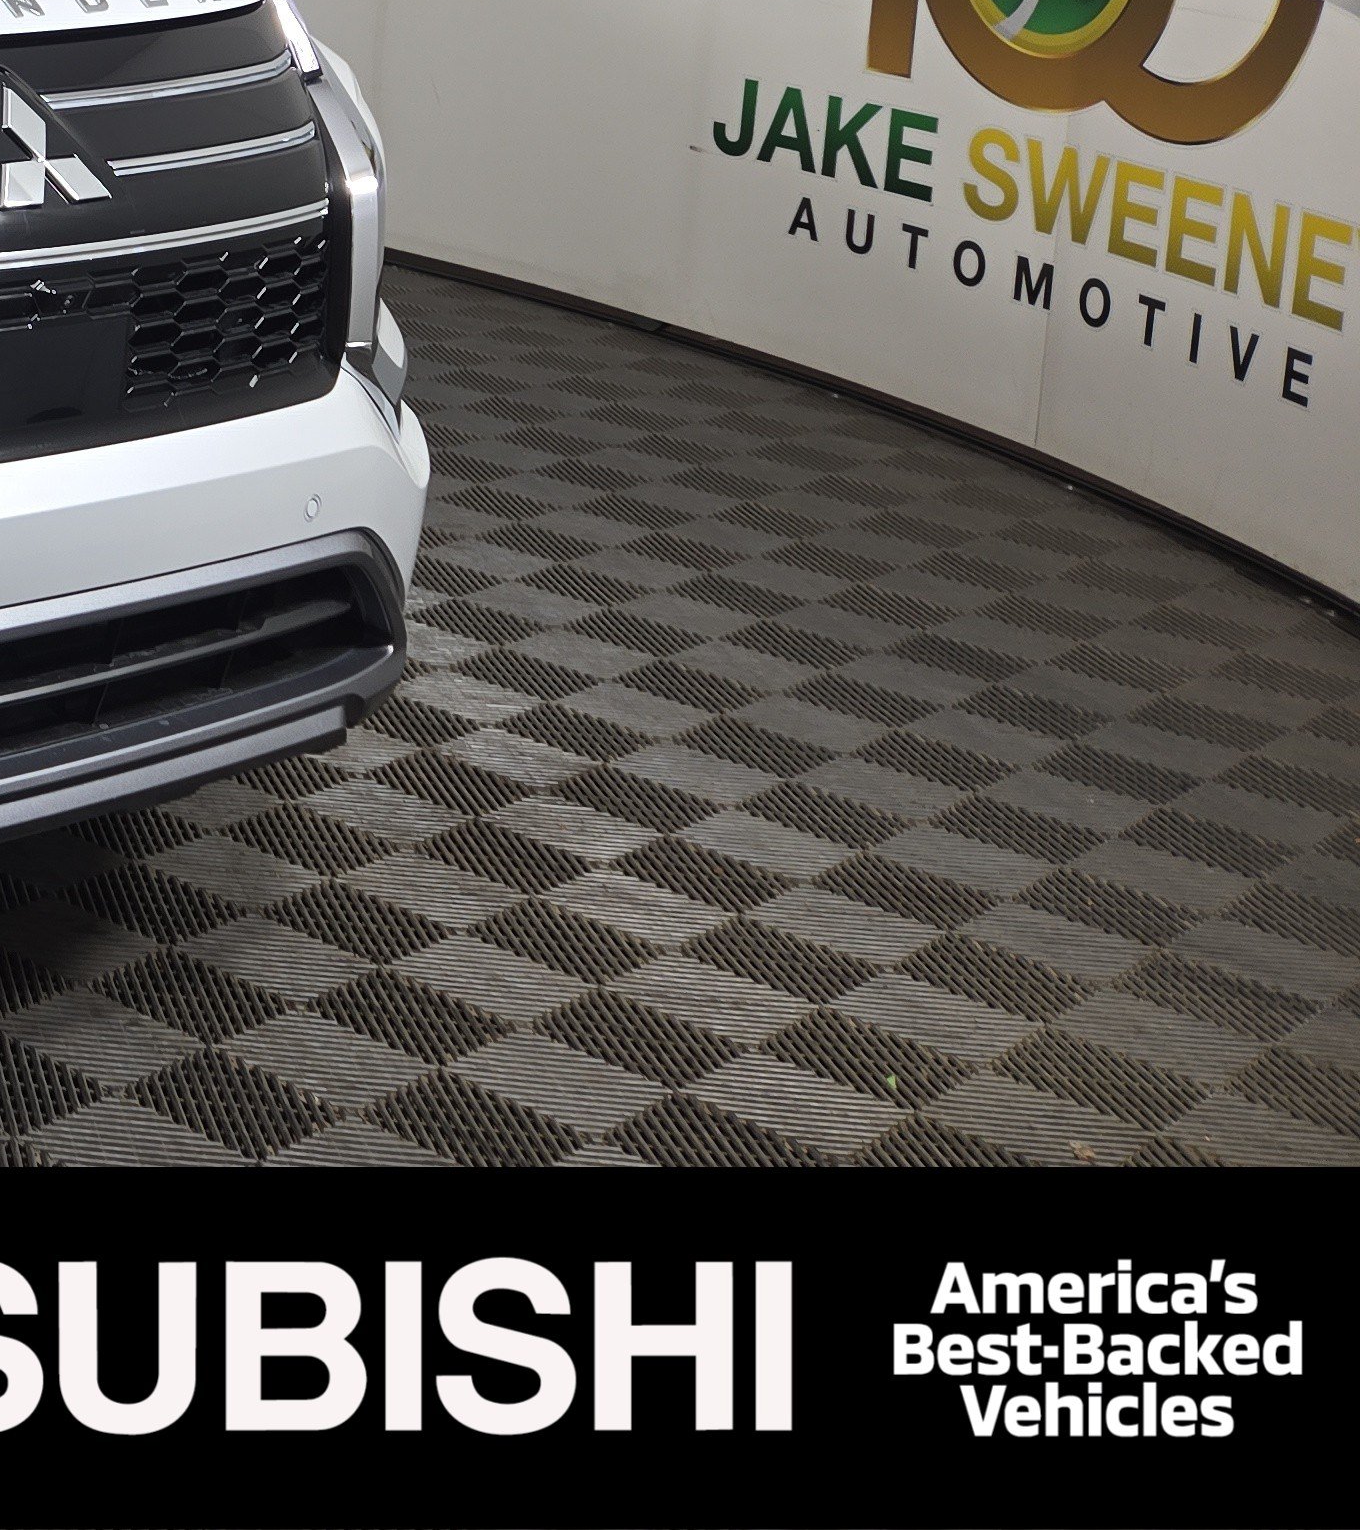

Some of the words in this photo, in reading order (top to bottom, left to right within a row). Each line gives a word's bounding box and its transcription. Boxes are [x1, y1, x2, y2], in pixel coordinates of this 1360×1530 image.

[712, 78, 940, 204] JAKE
[963, 127, 1360, 332] SWEENE
[787, 197, 1314, 408] AUTOMOTIVE
